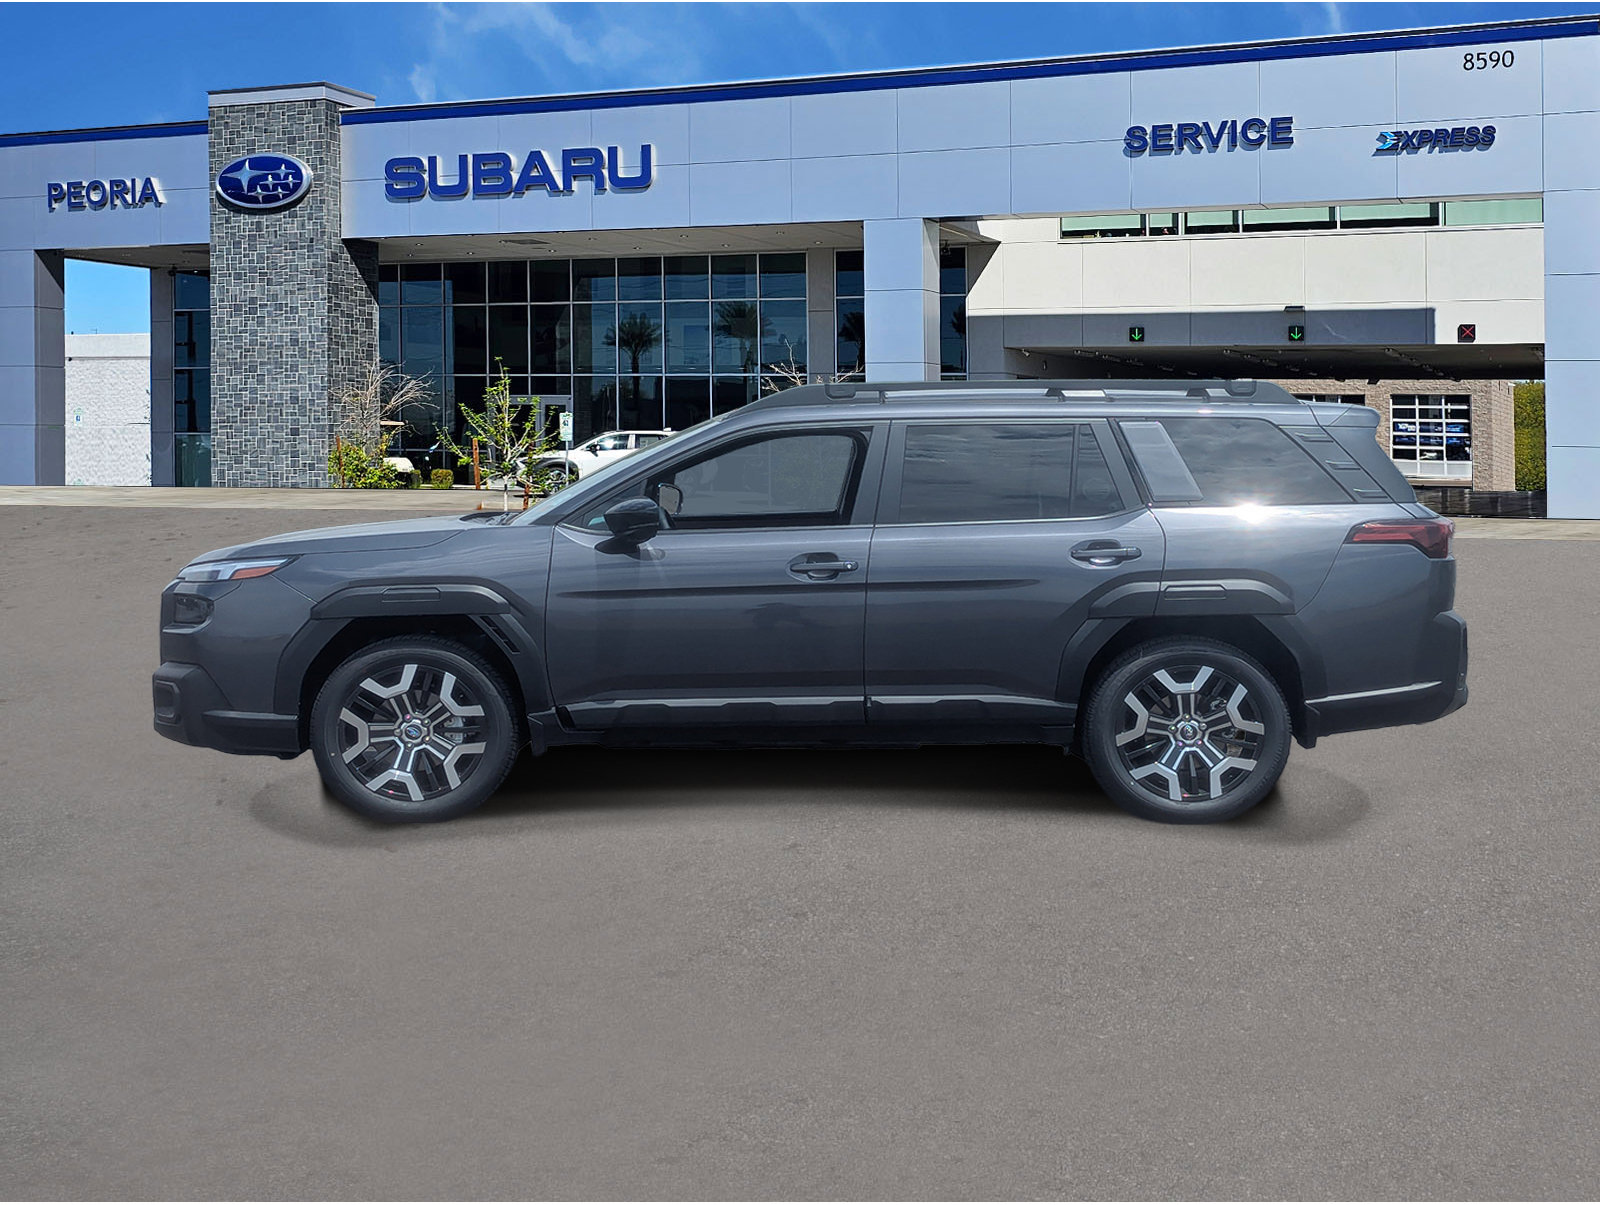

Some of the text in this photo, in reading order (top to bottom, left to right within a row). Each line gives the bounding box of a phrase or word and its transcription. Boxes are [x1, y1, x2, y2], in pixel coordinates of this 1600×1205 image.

[1463, 50, 1514, 71] 8590
[1125, 116, 1294, 153] SERVICE
[1376, 125, 1497, 152] EXPRESS
[384, 143, 652, 199] SUBARU
[47, 177, 161, 211] PEORIA
